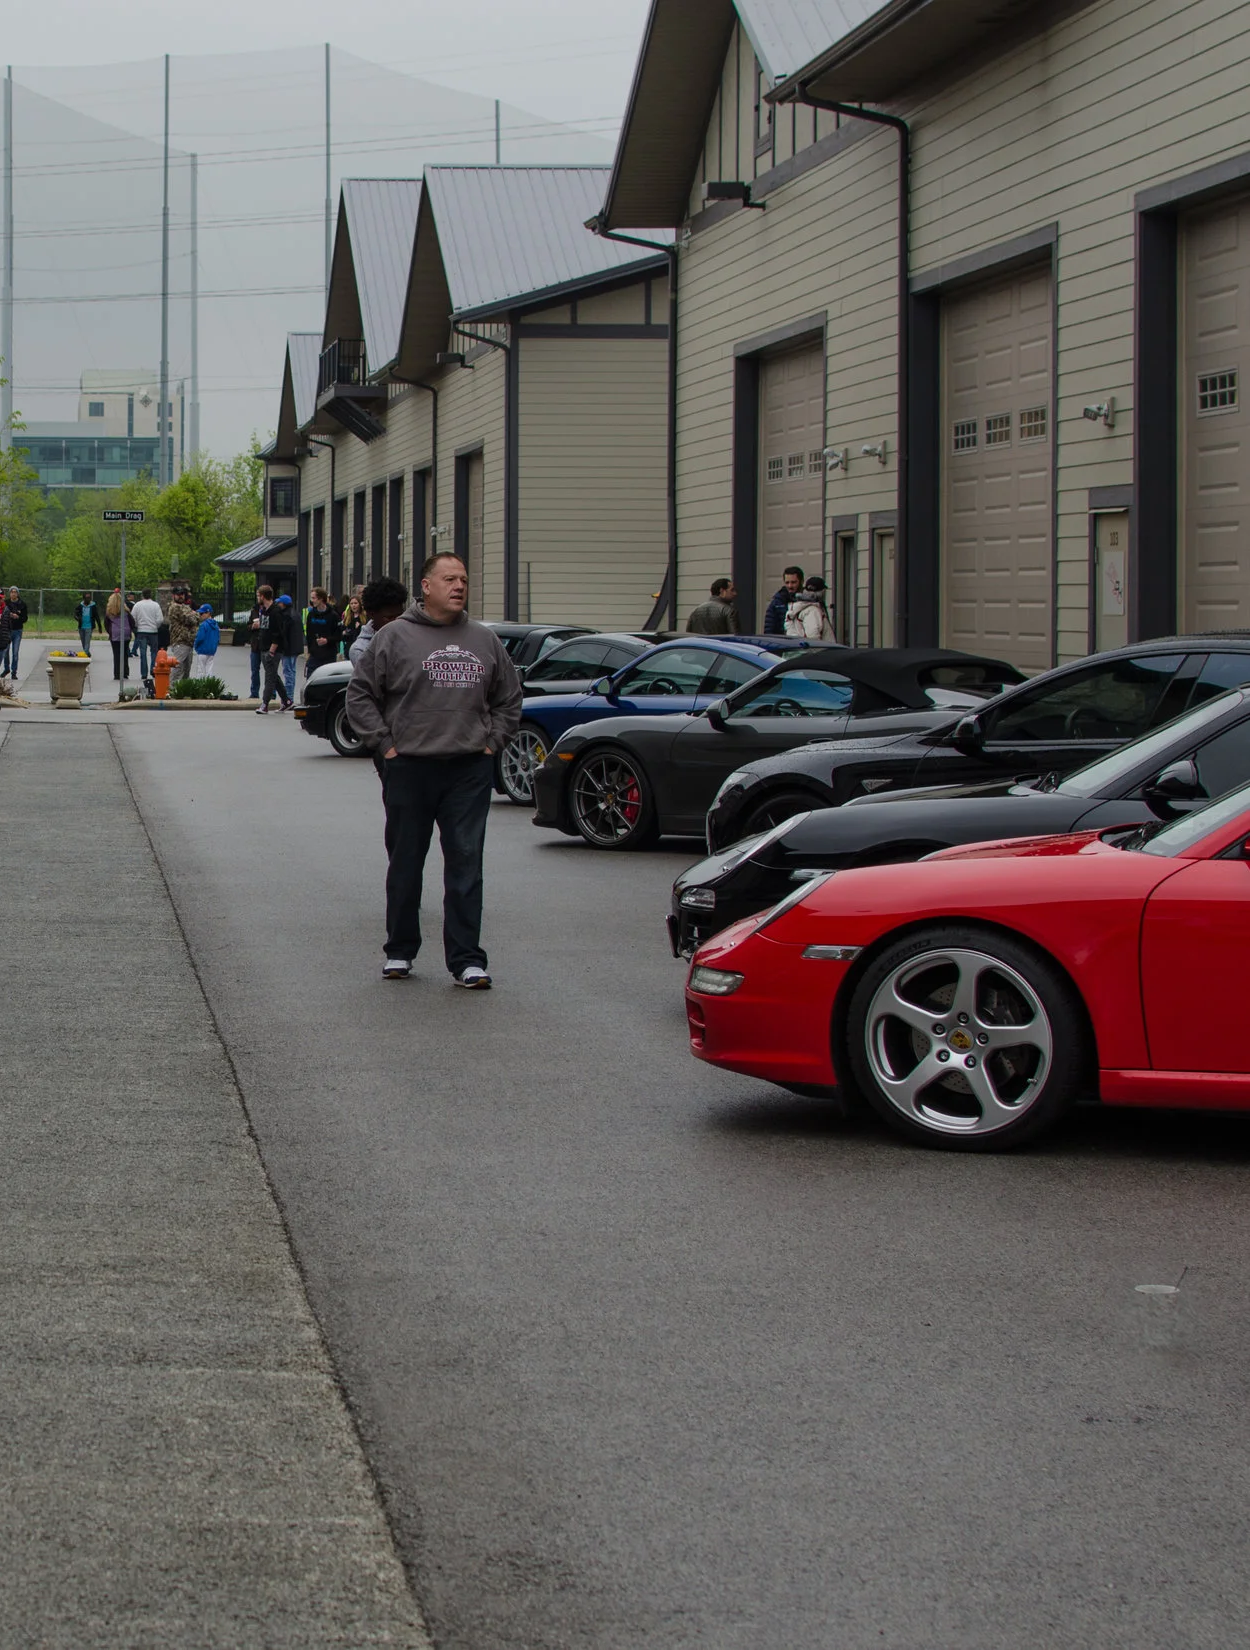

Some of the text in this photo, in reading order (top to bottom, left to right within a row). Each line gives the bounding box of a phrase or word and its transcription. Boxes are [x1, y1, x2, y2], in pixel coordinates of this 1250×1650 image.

[125, 512, 142, 520] Drag
[422, 660, 485, 674] PROWLER
[429, 670, 480, 683] FOOTBALL
